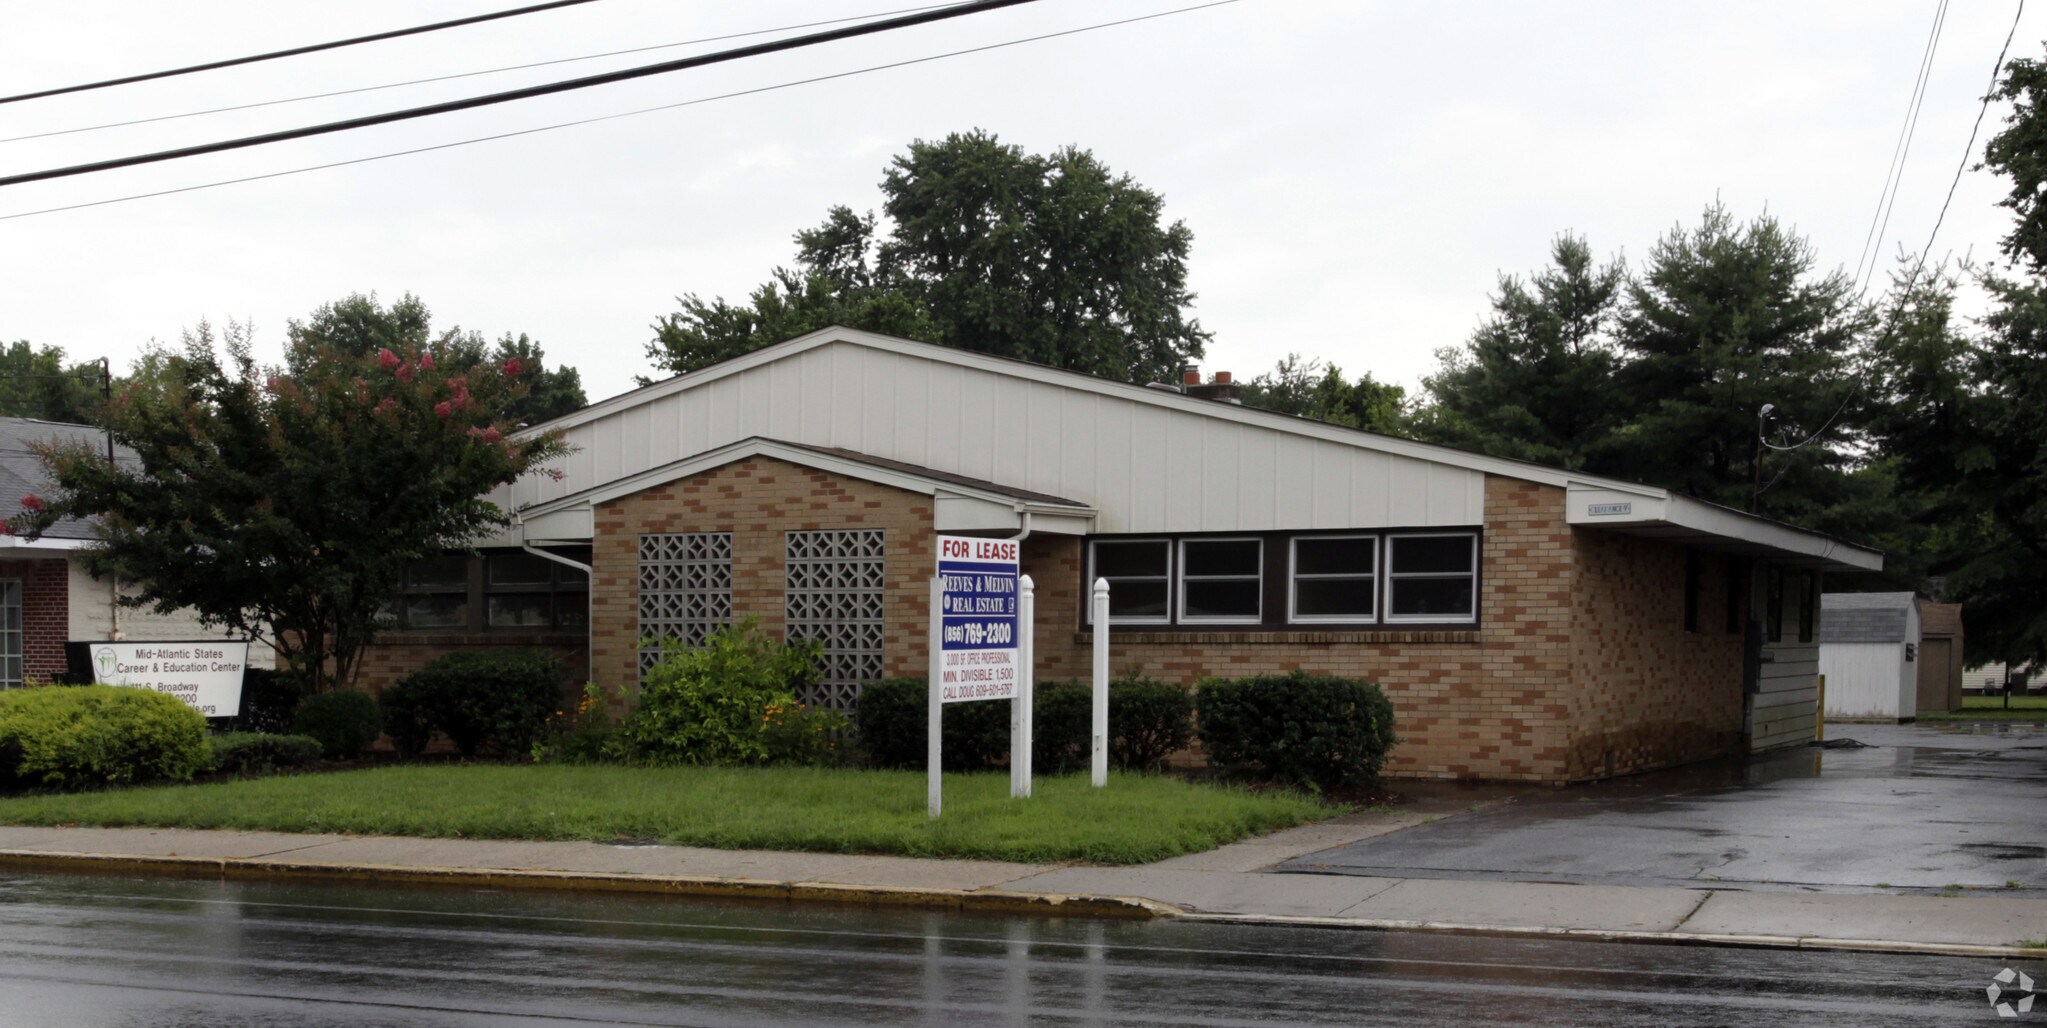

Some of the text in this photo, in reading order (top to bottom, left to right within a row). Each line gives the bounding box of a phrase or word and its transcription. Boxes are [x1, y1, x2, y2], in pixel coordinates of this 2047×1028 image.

[943, 540, 1016, 560] FOR LEASE
[942, 574, 1014, 593] REEVES & MELVIN
[952, 597, 1004, 613] REAL ESTATE
[944, 622, 1011, 644] (856) 769-2300
[135, 648, 223, 660] Mid-Atlantic States
[967, 652, 980, 665] OFFICE
[981, 651, 1011, 665] PROFESSIONAL
[117, 662, 241, 674] Career & Education Center
[943, 667, 1013, 683] MIN. DIVISIBLE 1,500
[157, 682, 199, 694] Broadway
[943, 686, 957, 699] CALL
[959, 685, 974, 698] DOUG
